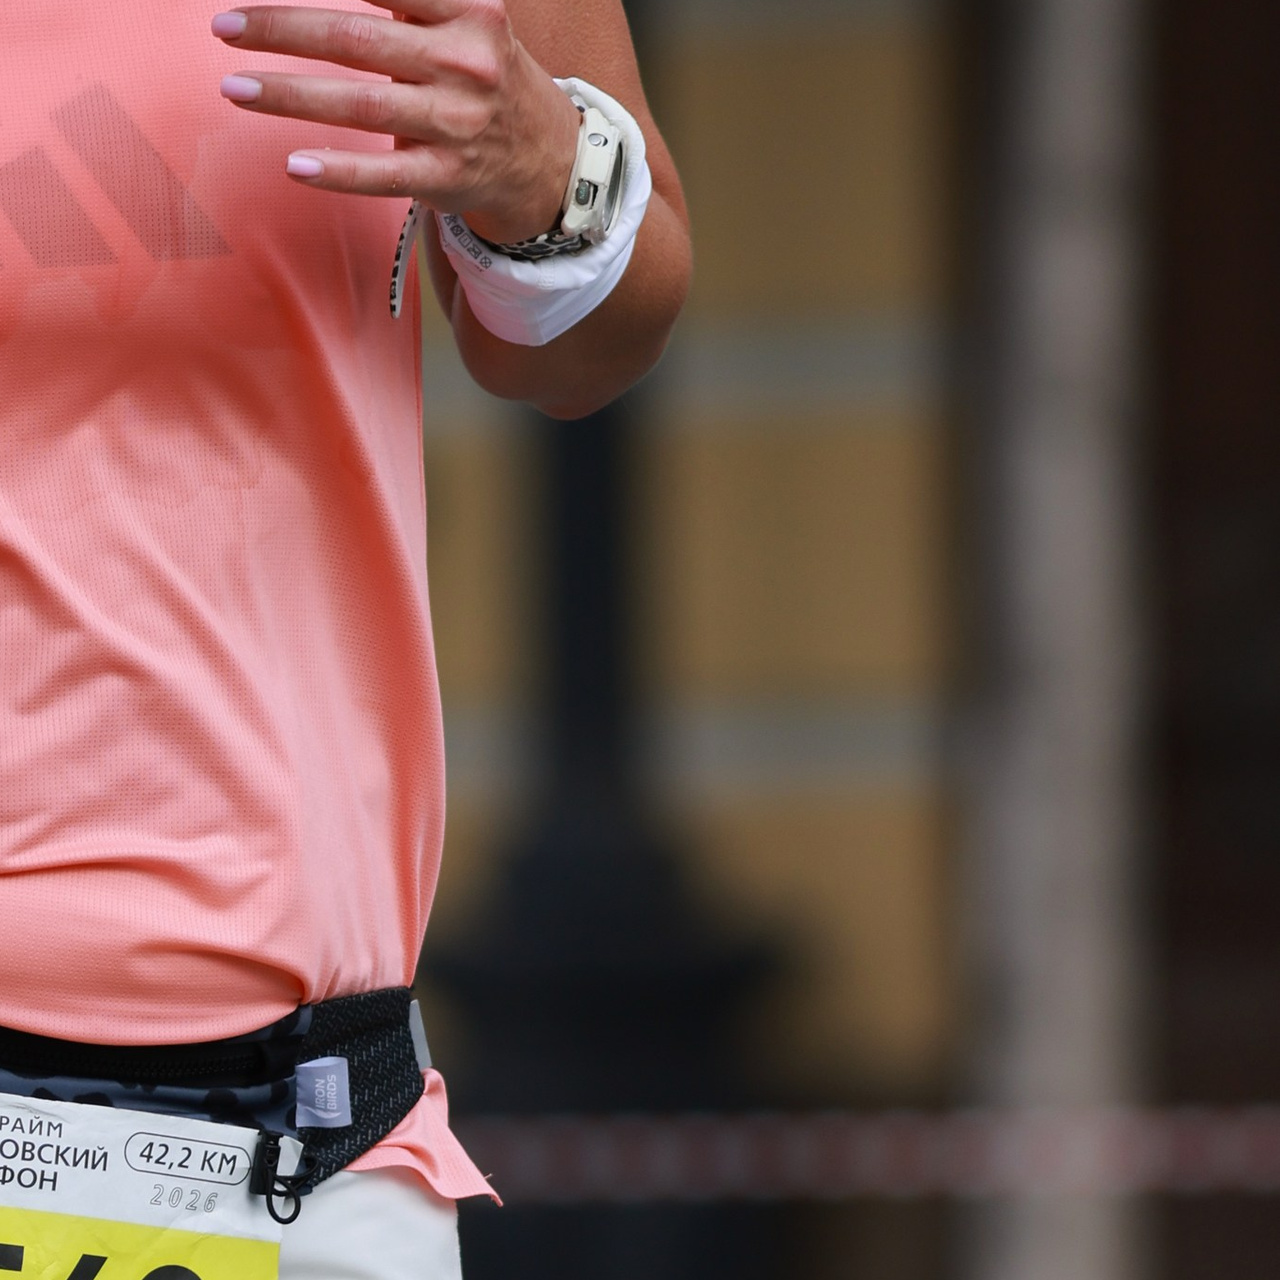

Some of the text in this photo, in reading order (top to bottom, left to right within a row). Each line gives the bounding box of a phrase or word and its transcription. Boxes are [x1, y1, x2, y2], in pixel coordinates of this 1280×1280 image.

[315, 1079, 326, 1109] IRON
[326, 1074, 337, 1110] BIRDS
[138, 1141, 193, 1170] 42,2
[149, 1183, 218, 1213] 2026
